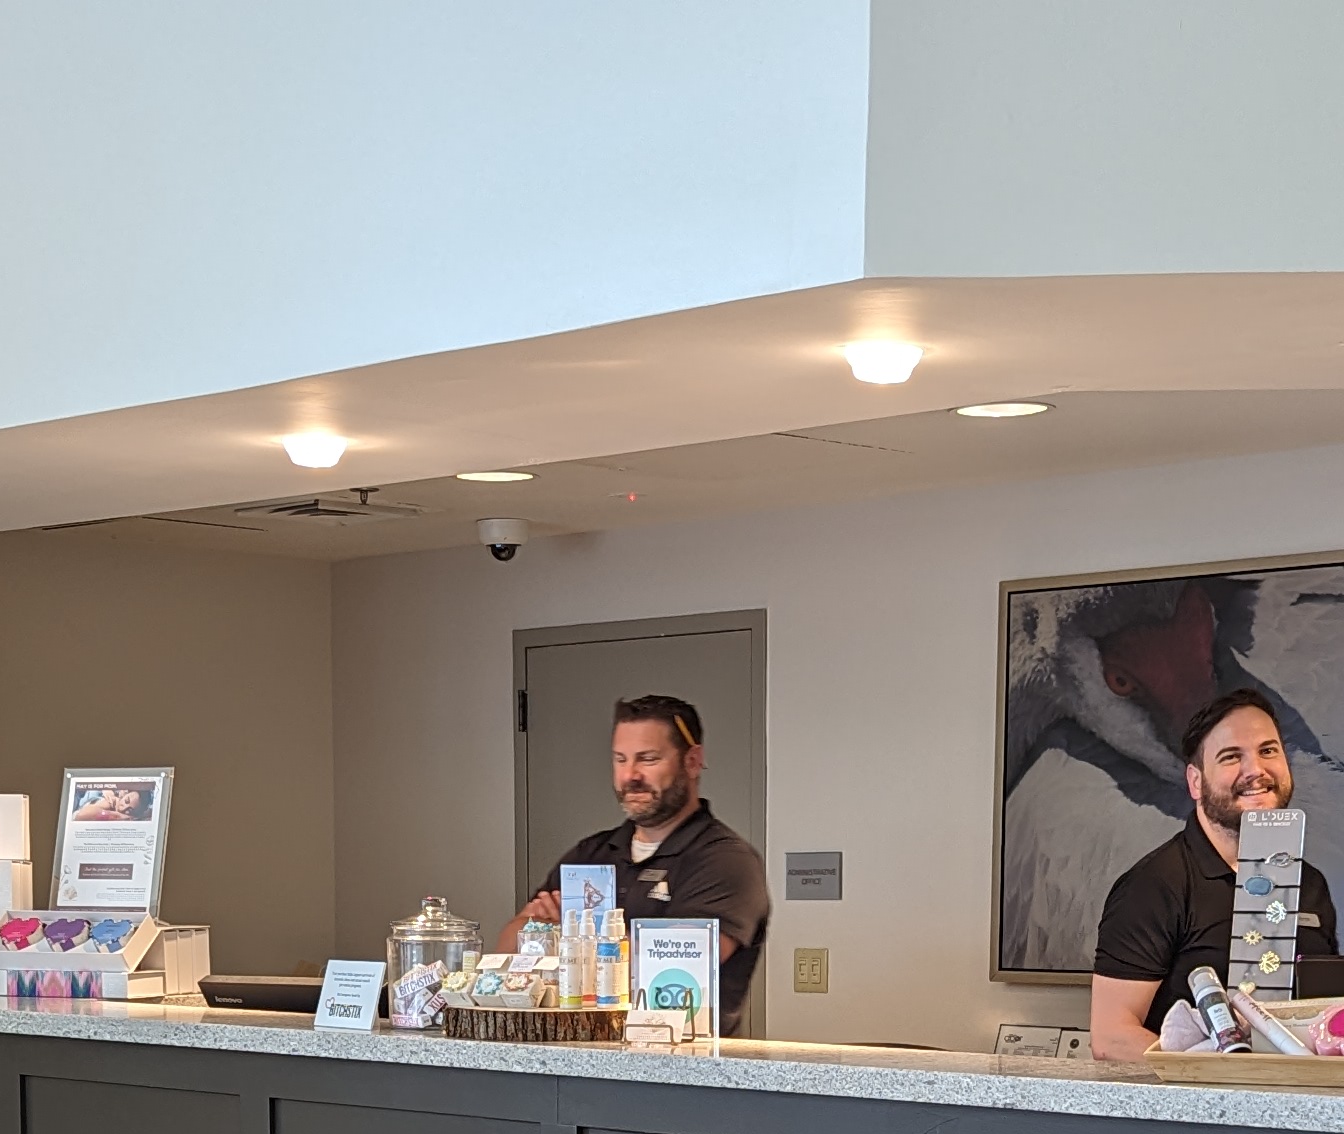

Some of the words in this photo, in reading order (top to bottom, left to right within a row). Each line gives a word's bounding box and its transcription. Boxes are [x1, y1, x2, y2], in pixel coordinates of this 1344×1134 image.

[653, 939, 682, 949] We're
[683, 940, 696, 949] on
[647, 949, 702, 960] Tripadvisor
[398, 972, 435, 996] BITCHSTIX
